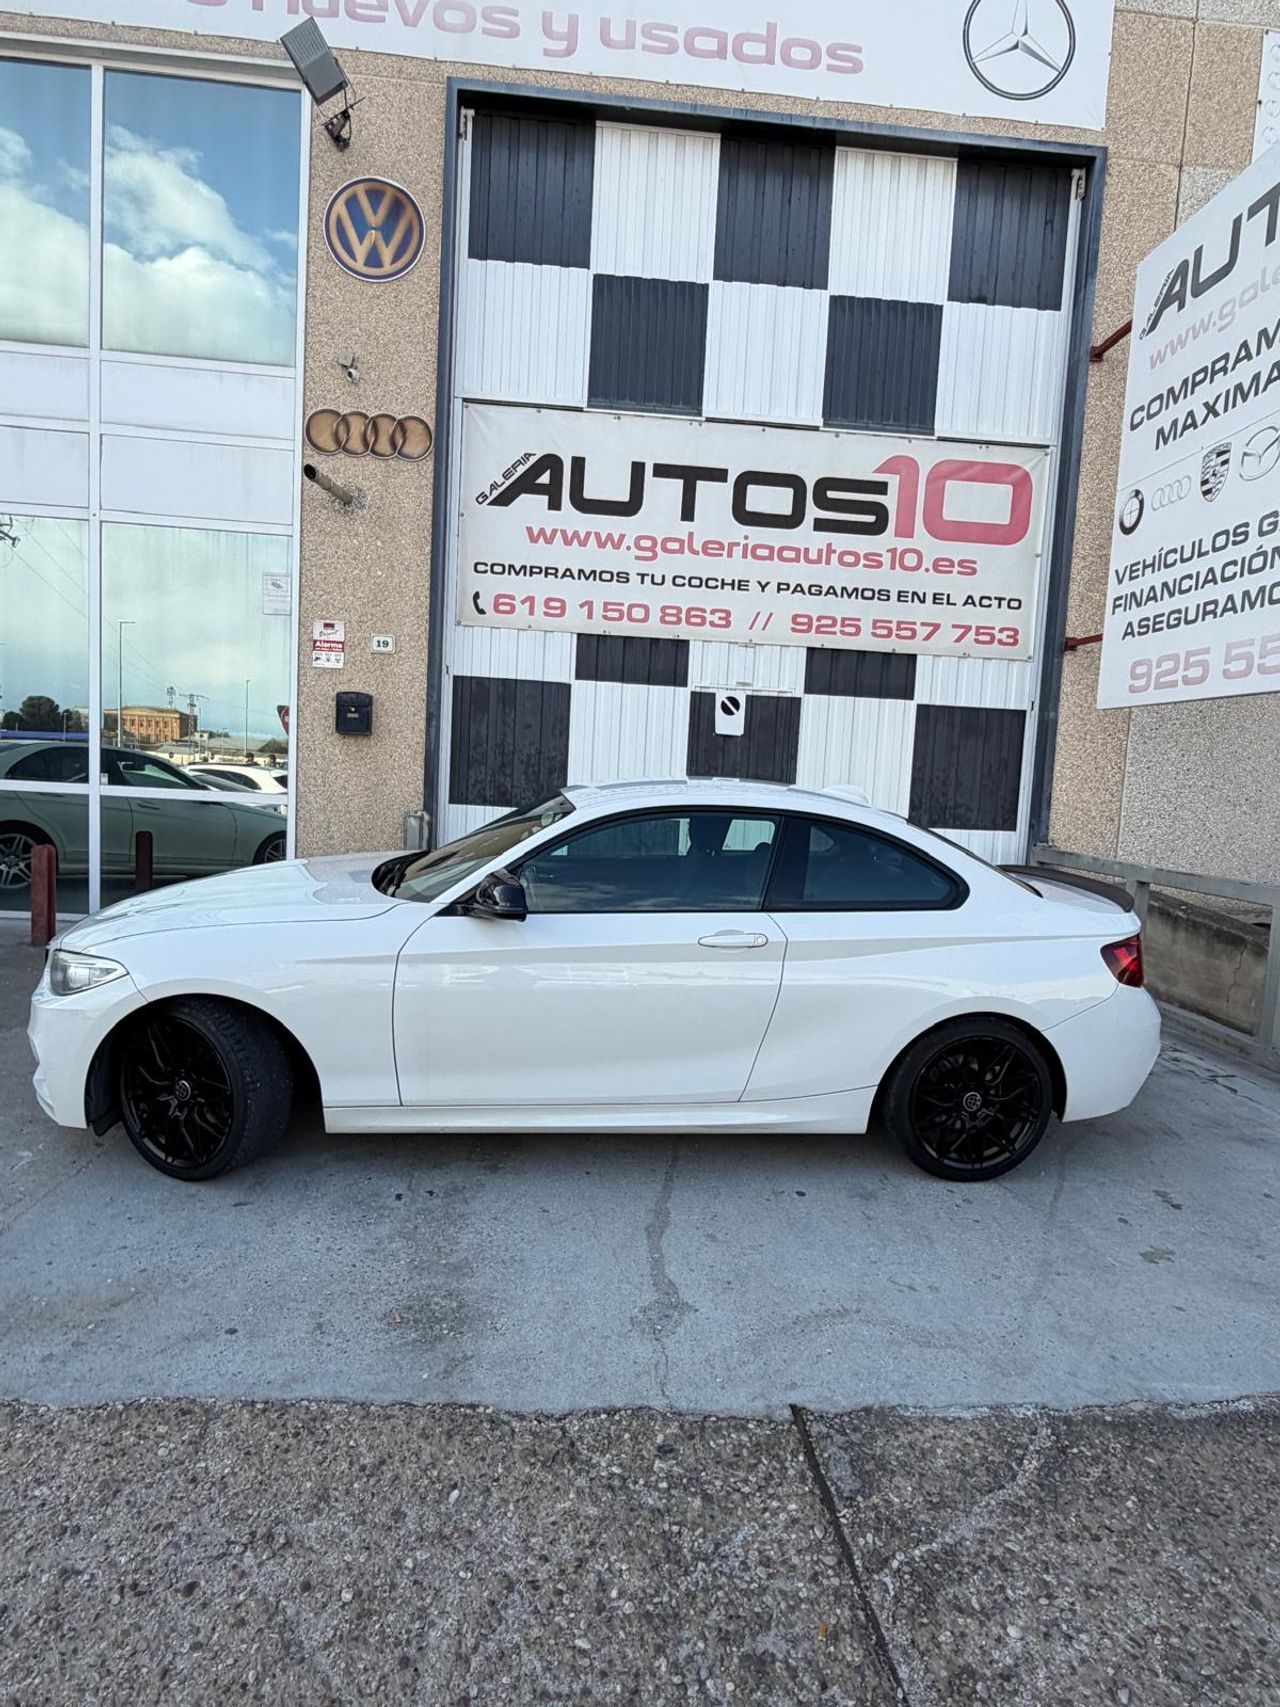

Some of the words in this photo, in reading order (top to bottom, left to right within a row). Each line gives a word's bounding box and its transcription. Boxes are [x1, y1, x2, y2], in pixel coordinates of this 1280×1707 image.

[542, 11, 578, 58] y
[600, 16, 864, 75] usados
[1155, 360, 1280, 451] MAXIMA
[475, 452, 537, 505] GALERIA
[486, 452, 1033, 546] AUTOS10
[525, 526, 978, 577] www.galeriaautos10.es
[1114, 521, 1250, 586] VEHÍCULOS
[1257, 510, 1280, 537] G
[473, 562, 630, 584] COMPRAMOS
[636, 572, 665, 586] TU
[671, 574, 750, 592] COCHE
[756, 581, 771, 593] Y
[776, 582, 891, 602] PAGAMOS
[896, 590, 927, 605] EN
[932, 593, 957, 607] EL
[962, 595, 1023, 610] ACTO
[376, 639, 389, 648] 19
[493, 593, 567, 618] 619
[578, 600, 650, 623] 150
[659, 604, 732, 629] 863
[790, 613, 862, 637] 925
[871, 619, 941, 642] 557
[951, 624, 1020, 647] 753
[1128, 646, 1211, 694] 925
